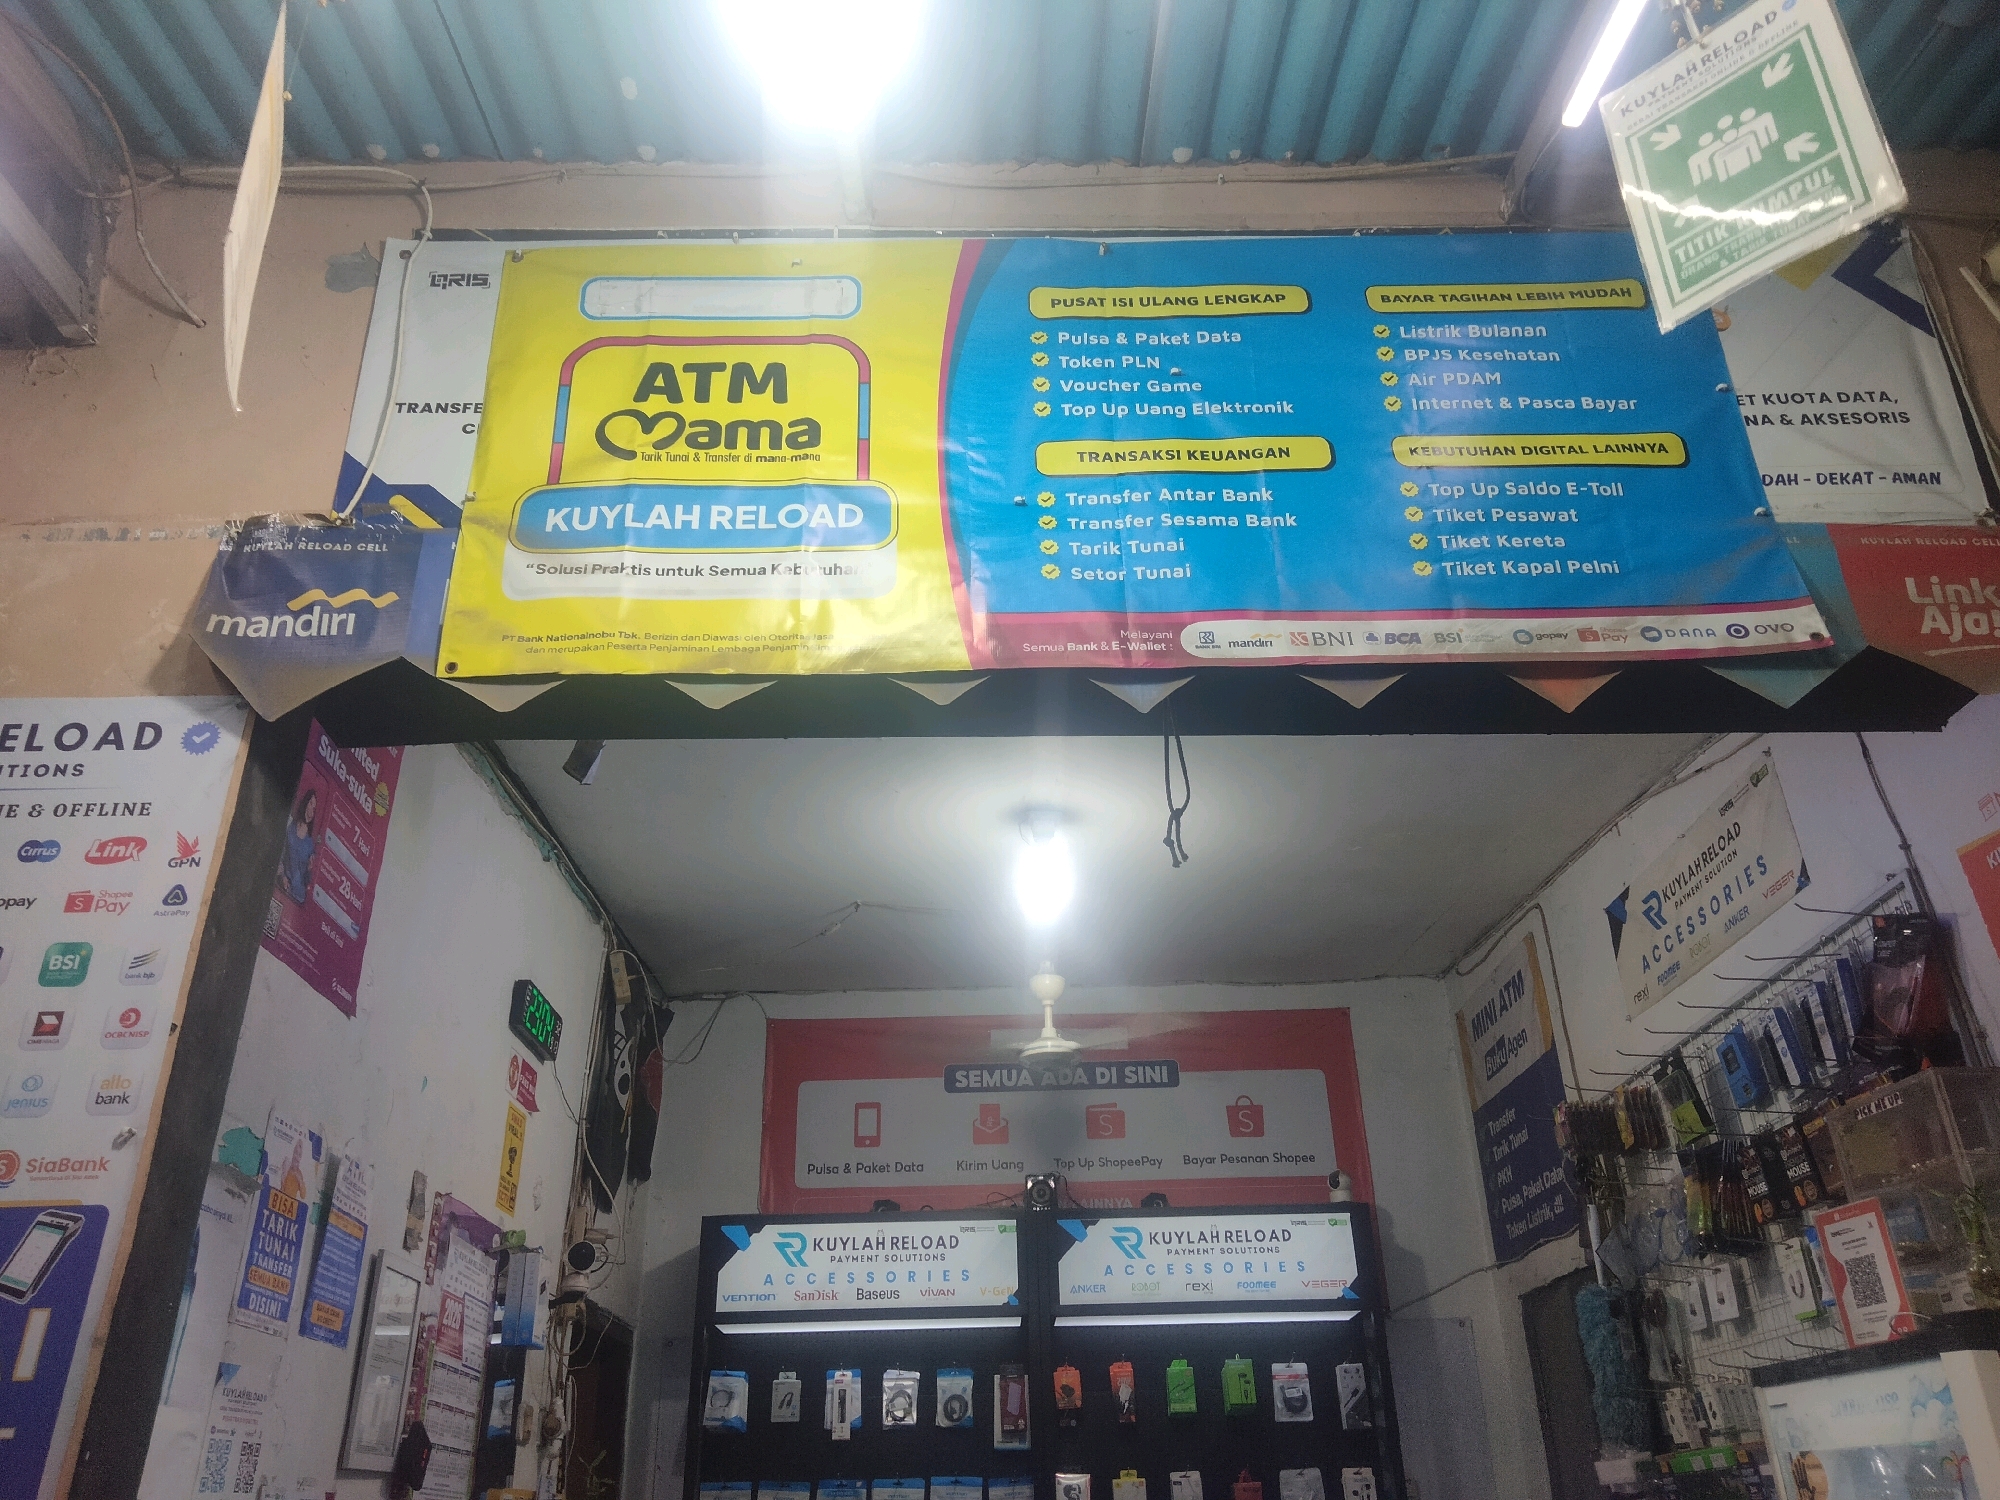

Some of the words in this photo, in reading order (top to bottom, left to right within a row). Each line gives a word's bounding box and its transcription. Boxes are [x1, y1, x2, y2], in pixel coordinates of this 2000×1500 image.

[1647, 78, 1693, 108] PAYMENT
[1699, 37, 1757, 76] SOLUTIONS
[1675, 223, 1729, 263] TITIK
[1737, 166, 1835, 230] KMPUL
[429, 272, 491, 289] QRIS
[1050, 297, 1107, 308] PUSAT
[1113, 297, 1134, 307] ISI
[1139, 296, 1199, 307] ULANG
[1205, 294, 1286, 306] LENGKAP
[1381, 294, 1434, 303] BAYAR
[1439, 292, 1512, 303] TAGIHAN
[1517, 291, 1565, 301] LEBIH
[1570, 288, 1631, 299] MUDAH
[1058, 332, 1109, 345] Pulsa
[1116, 333, 1128, 344] &
[1136, 333, 1190, 345] Paket
[1197, 331, 1241, 343] Data
[1401, 325, 1461, 338] Listrik
[1468, 324, 1547, 338] Bulanan
[1059, 356, 1114, 368] Token
[1122, 356, 1160, 368] PLN
[1405, 349, 1453, 361] BPJS
[1459, 349, 1560, 362] Kesehatan
[633, 362, 788, 404] ATM
[1060, 380, 1140, 392] Voucher
[1147, 380, 1202, 392] Game
[1409, 373, 1436, 385] Air
[1443, 373, 1501, 385] PDAM
[1412, 398, 1493, 411] Internet
[1500, 398, 1512, 410] &
[1518, 397, 1575, 410] Pasca
[1581, 397, 1637, 412] Bayar
[1763, 392, 1832, 406] KUOTA
[1837, 391, 1899, 405] DATA,
[1780, 414, 1794, 426] &
[1800, 411, 1910, 425] AKSESORIS
[1409, 446, 1516, 456] KEBUTUHAN
[1521, 445, 1588, 456] DIGITAL
[1593, 443, 1668, 454] LAINNYA
[641, 452, 662, 462] Tarik
[666, 452, 691, 463] Tunai
[693, 453, 700, 463] &
[704, 452, 740, 463] Transfer
[743, 453, 752, 463] di
[756, 453, 820, 463] mana-mana
[1816, 472, 1874, 486] DEKAT
[1892, 472, 1941, 485] AMAN
[1428, 483, 1464, 498] Top
[1471, 483, 1499, 498] Up
[1505, 482, 1561, 496] Saldo
[1567, 482, 1624, 497] E-Toll
[546, 504, 700, 533] KUYLAH
[710, 504, 863, 530] RELOAD
[1067, 515, 1153, 530] Transfer
[1161, 513, 1239, 527] Sesama
[1246, 513, 1297, 527] Bank
[1433, 509, 1485, 523] Tiket
[1492, 508, 1578, 523] Pesawat
[243, 542, 293, 553] KUYLAH
[298, 542, 352, 551] RELOAD
[357, 543, 389, 552] CELL
[1069, 541, 1120, 556] Tarik
[1128, 538, 1184, 554] Tunai
[1437, 535, 1490, 549] Tiket
[1497, 534, 1566, 548] Kereta
[1071, 567, 1126, 581] Setor
[1133, 564, 1191, 579] Tunai
[1442, 561, 1496, 576] Tiket
[1502, 560, 1561, 576] Kapal
[1567, 560, 1619, 574] Pelni
[1905, 576, 2000, 607] Link
[205, 605, 356, 638] mandiri
[1754, 623, 1794, 634] OVO
[1121, 630, 1173, 641] Melayani
[1313, 632, 1353, 646] BNI
[1536, 631, 1568, 641] gopay
[1666, 627, 1716, 638] DANA
[525, 645, 545, 654] dan
[548, 645, 604, 654] merupakan
[607, 643, 647, 653] Peserta
[649, 644, 709, 654] Penjaminan
[712, 644, 760, 654] Lembaga
[1023, 643, 1064, 652] Semua
[1067, 643, 1098, 651] Bank
[1100, 643, 1109, 652] &
[1112, 642, 1164, 652] E-Wallet
[1228, 638, 1272, 648] mandiri
[319, 735, 373, 815] Suka-suka
[28, 804, 45, 818] &
[53, 802, 152, 817] OFFLINE
[21, 845, 58, 856] Cirrus
[88, 839, 141, 861] Link
[168, 857, 201, 868] GPN
[1674, 880, 1703, 910] PAYMENT
[1705, 849, 1738, 884] SOLUTION
[1761, 869, 1795, 900] VEGER
[98, 890, 133, 898] Shopee
[339, 876, 350, 899] 28
[94, 900, 130, 915] Pay
[1642, 854, 1768, 974] ACCESSORIES
[1724, 905, 1750, 934] ANKER
[49, 954, 80, 970] BSI
[1471, 997, 1498, 1042] MINI
[1499, 969, 1525, 1018] ATM
[100, 1075, 131, 1090] allo
[955, 1069, 1034, 1088] SEMUA
[1040, 1066, 1087, 1086] ADA
[1096, 1066, 1117, 1083] DI
[1124, 1065, 1169, 1084] SINI
[4, 1096, 48, 1111] jenius
[95, 1092, 131, 1105] bank
[1488, 1107, 1516, 1137] Transfer
[956, 1160, 988, 1172] Kirim
[992, 1159, 1024, 1173] Uang
[1053, 1157, 1075, 1170] Top
[1078, 1157, 1095, 1171] Up
[1098, 1156, 1163, 1169] ShopeePay
[1183, 1154, 1217, 1167] Bayar
[1220, 1153, 1269, 1164] Pesanan
[1273, 1152, 1315, 1166] Shopee
[807, 1162, 839, 1175] Pulsa
[843, 1163, 852, 1174] &
[856, 1162, 890, 1174] Paket
[894, 1161, 924, 1173] Data
[1787, 1161, 1810, 1178] MOUSE
[270, 1189, 296, 1217] BISA
[262, 1209, 297, 1242] TARIK
[259, 1231, 295, 1262] TUNAI
[1167, 1248, 1215, 1256] PAYMENT
[1220, 1246, 1280, 1254] SOLUTIONS
[253, 1252, 293, 1278] TRANSFER
[830, 1254, 880, 1263] PAYMENT
[884, 1253, 946, 1262] SOLUTIONS
[1104, 1261, 1306, 1276] ACCESSORIES
[763, 1269, 970, 1286] ACCESSORIES
[1237, 1281, 1276, 1289] FOOMEE
[1301, 1280, 1348, 1288] VEGER
[856, 1287, 900, 1300] Baseus
[1070, 1284, 1106, 1293] ANKER
[1131, 1281, 1161, 1291] ROBOT
[722, 1293, 776, 1302] VENTION
[794, 1289, 839, 1301] SanDisk
[249, 1294, 282, 1318] DISINI
